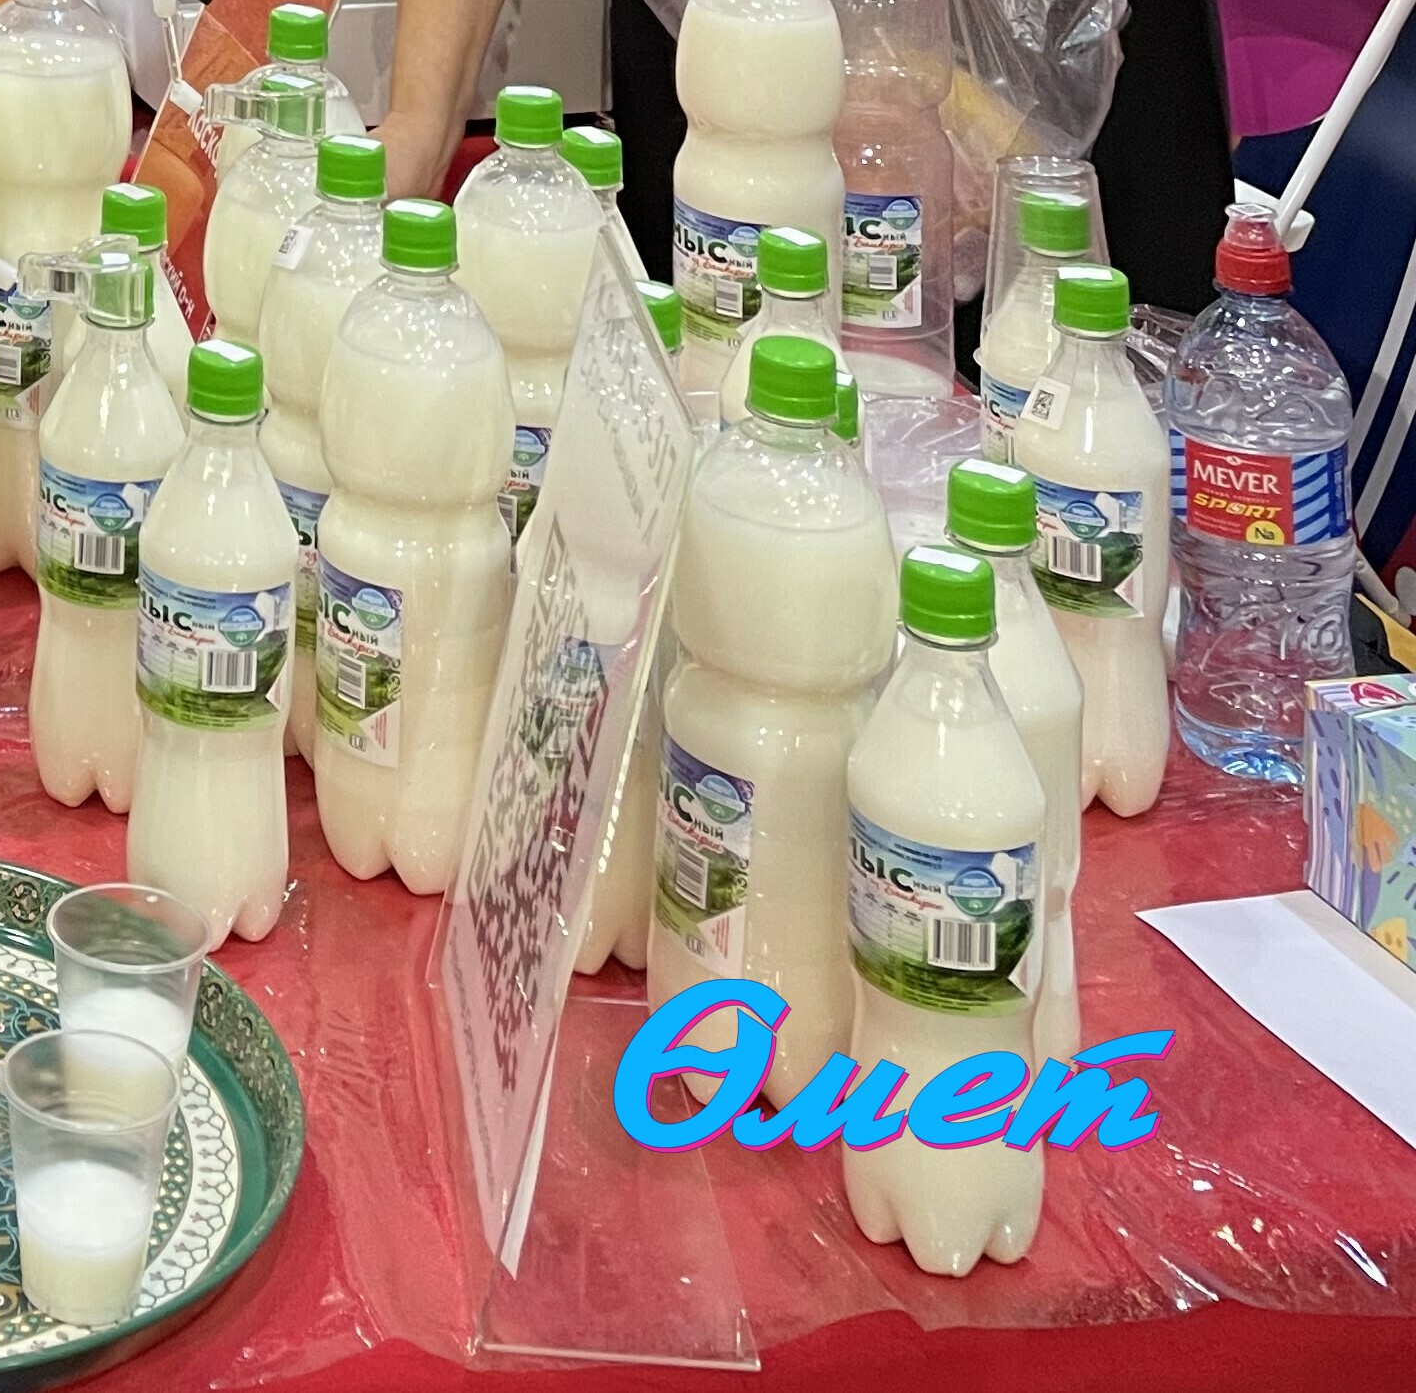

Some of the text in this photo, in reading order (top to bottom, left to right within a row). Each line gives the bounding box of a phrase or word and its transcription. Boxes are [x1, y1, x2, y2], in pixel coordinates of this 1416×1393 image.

[1192, 459, 1283, 495] MEVER
[1192, 492, 1283, 519] SPORT
[1253, 527, 1276, 541] Na
